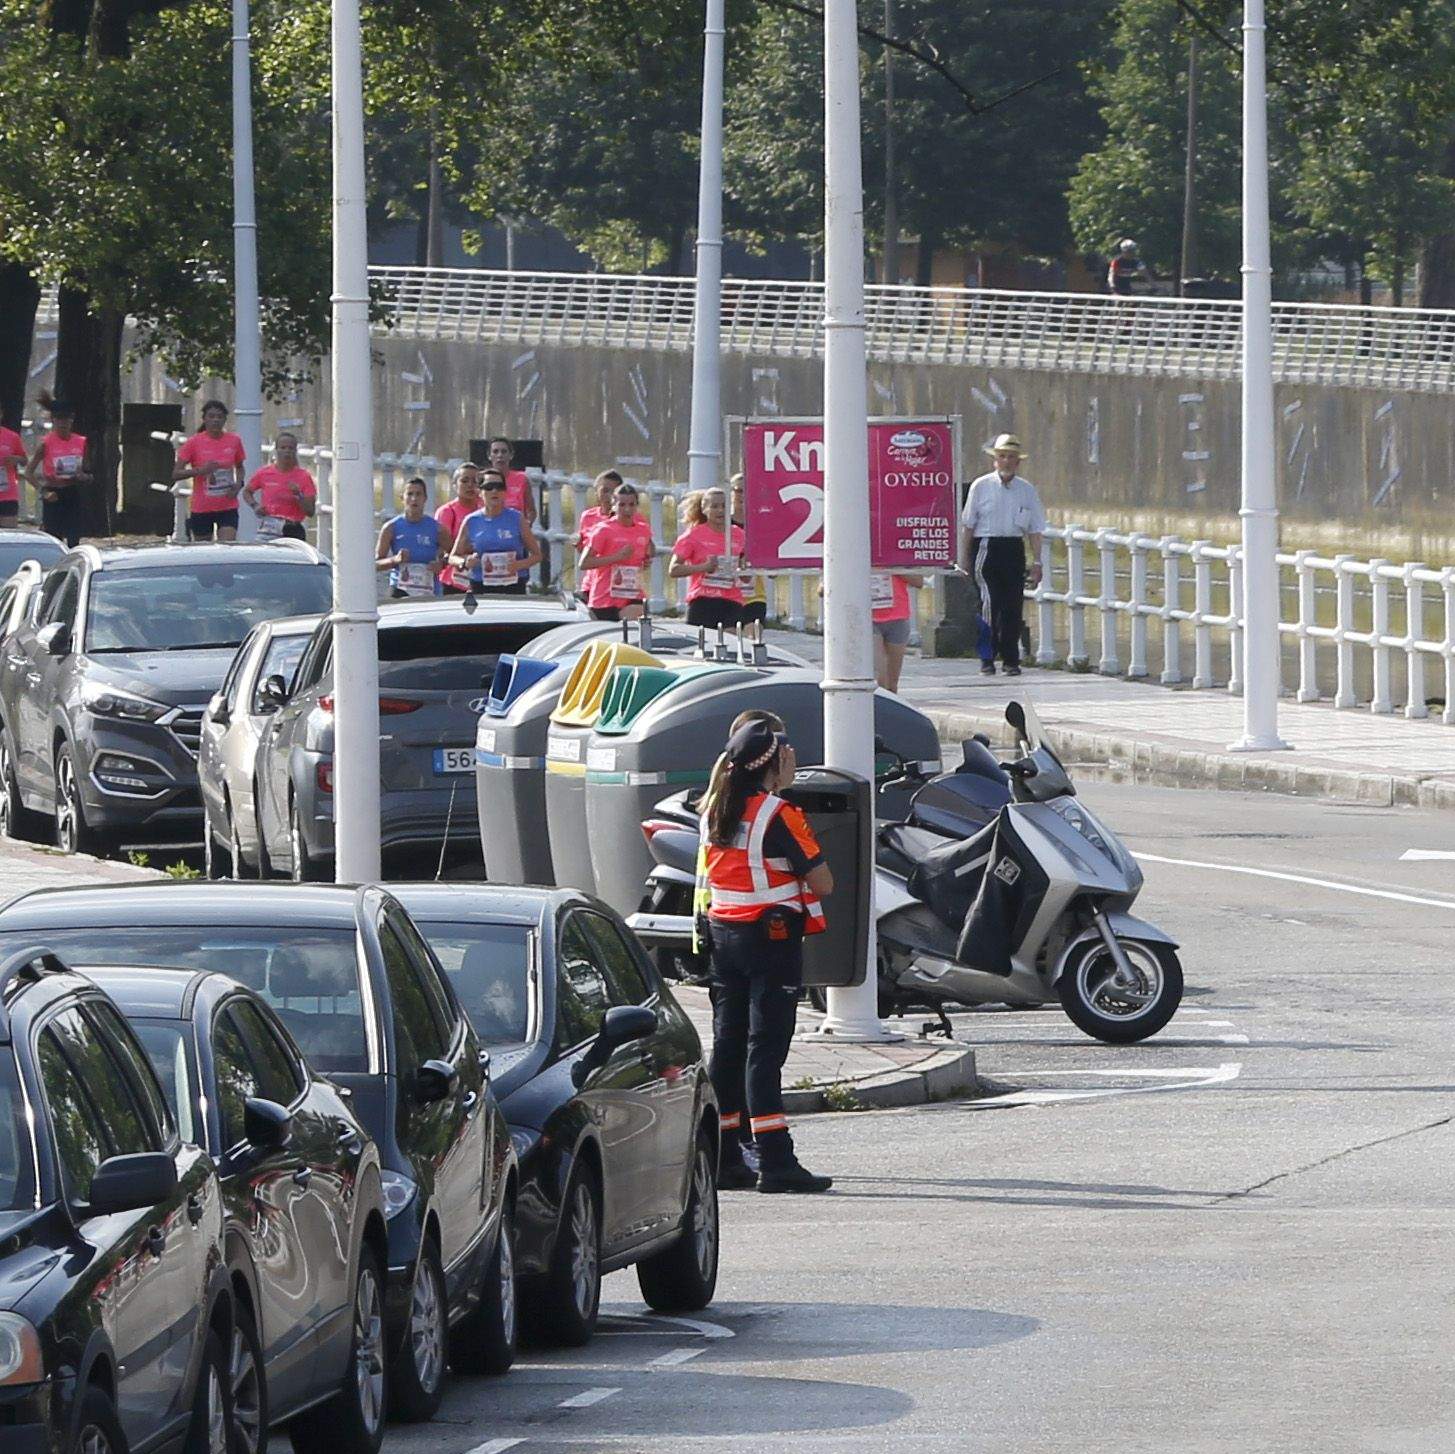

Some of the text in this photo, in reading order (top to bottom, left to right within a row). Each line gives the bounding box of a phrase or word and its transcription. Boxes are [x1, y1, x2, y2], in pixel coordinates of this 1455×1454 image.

[884, 471, 949, 487] OYSHO
[778, 483, 825, 559] 2
[896, 517, 949, 527] DISFRUTA
[912, 528, 949, 538] DE LOS
[898, 539, 949, 549] GRANDES
[914, 550, 949, 560] RETOS
[447, 751, 476, 768] 56
